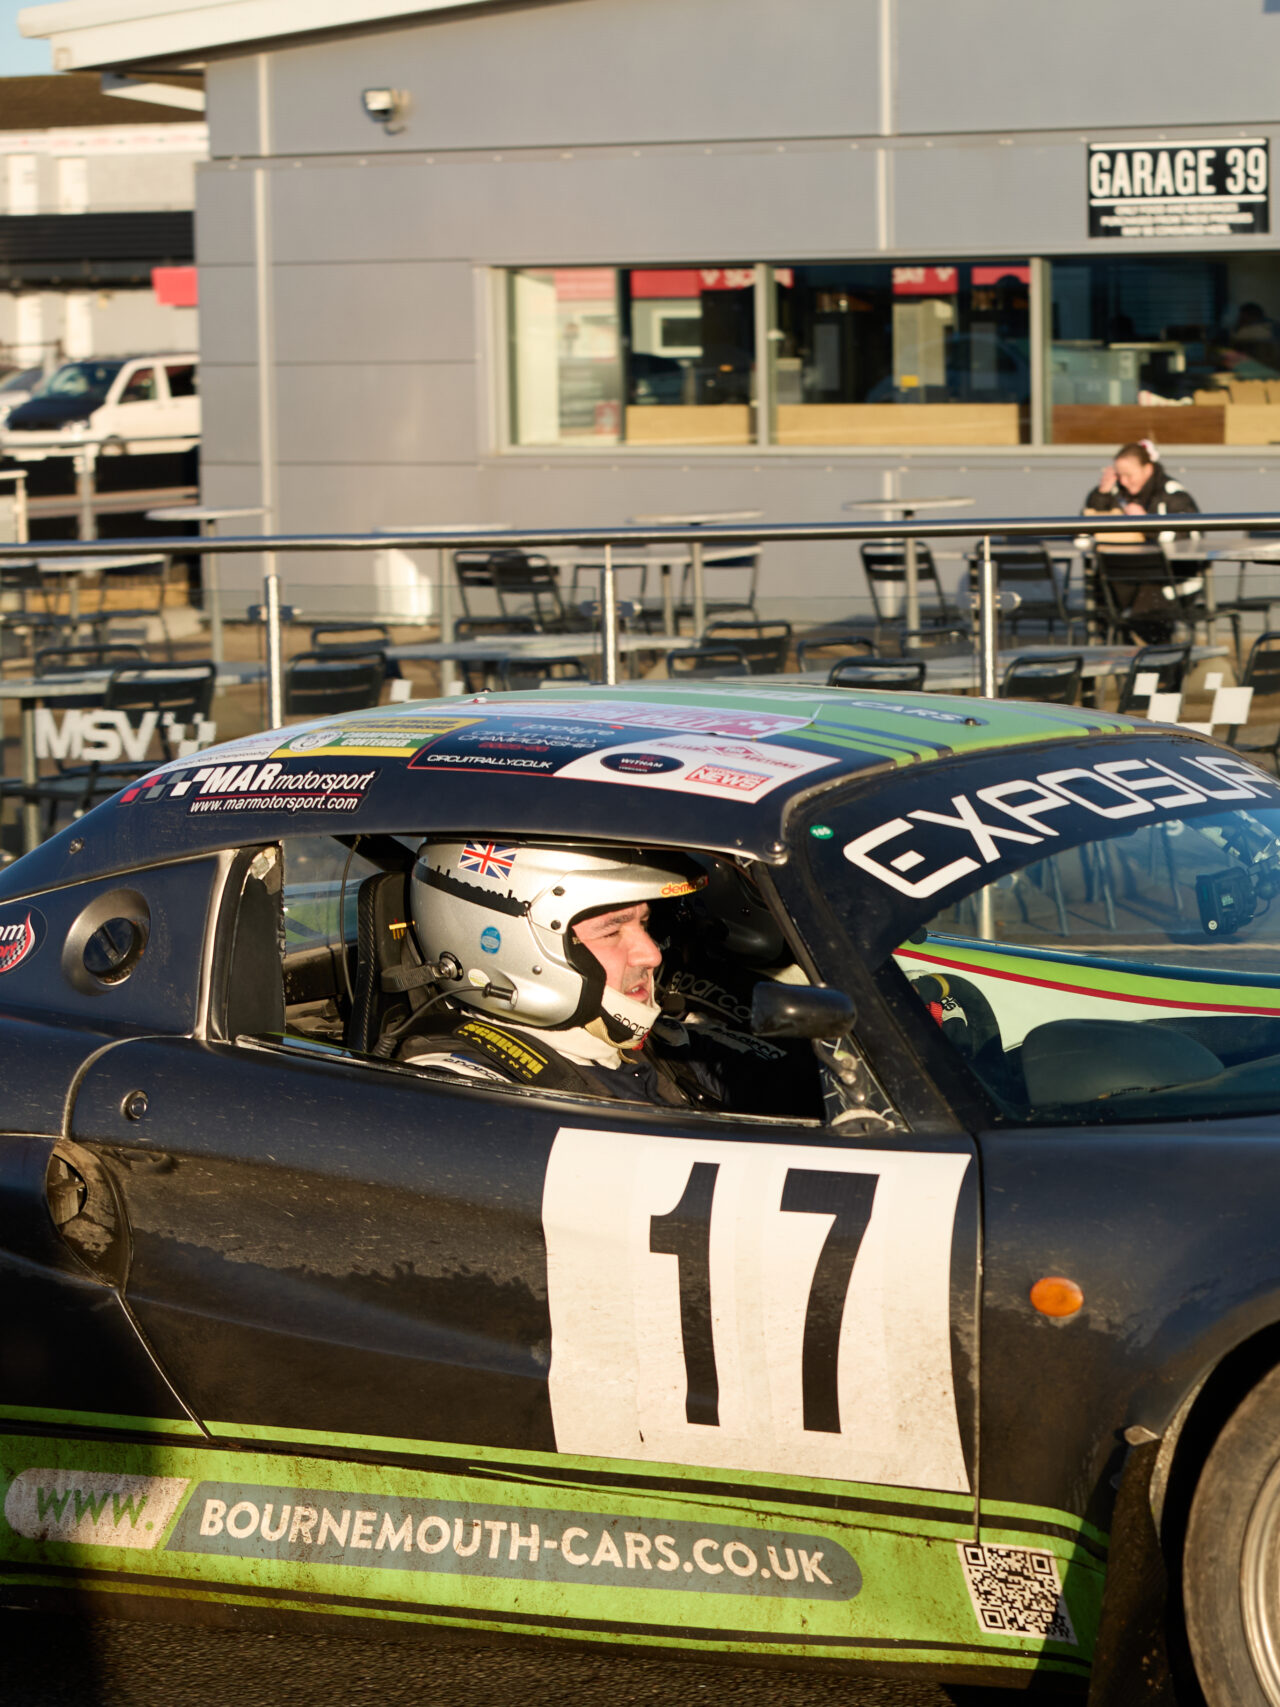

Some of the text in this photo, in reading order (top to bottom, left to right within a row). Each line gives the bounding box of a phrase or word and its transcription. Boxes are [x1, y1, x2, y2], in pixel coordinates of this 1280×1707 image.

[1089, 147, 1267, 198] GARAGE 39
[851, 700, 964, 721] CARS
[35, 707, 160, 762] MSV
[458, 735, 596, 749] CHAMPIONSHIP
[426, 754, 554, 769] CIRCUITRALLY.CO.UK
[620, 757, 664, 769] WITHAM
[691, 768, 763, 789] NEWS
[189, 794, 359, 814] www.marmotorsport.com
[670, 970, 752, 1020] sparco
[463, 1023, 544, 1075] SCHROTH
[649, 1161, 881, 1435] 17
[199, 1498, 833, 1586] BOURNEMOUTH-CARS.CO.UK
